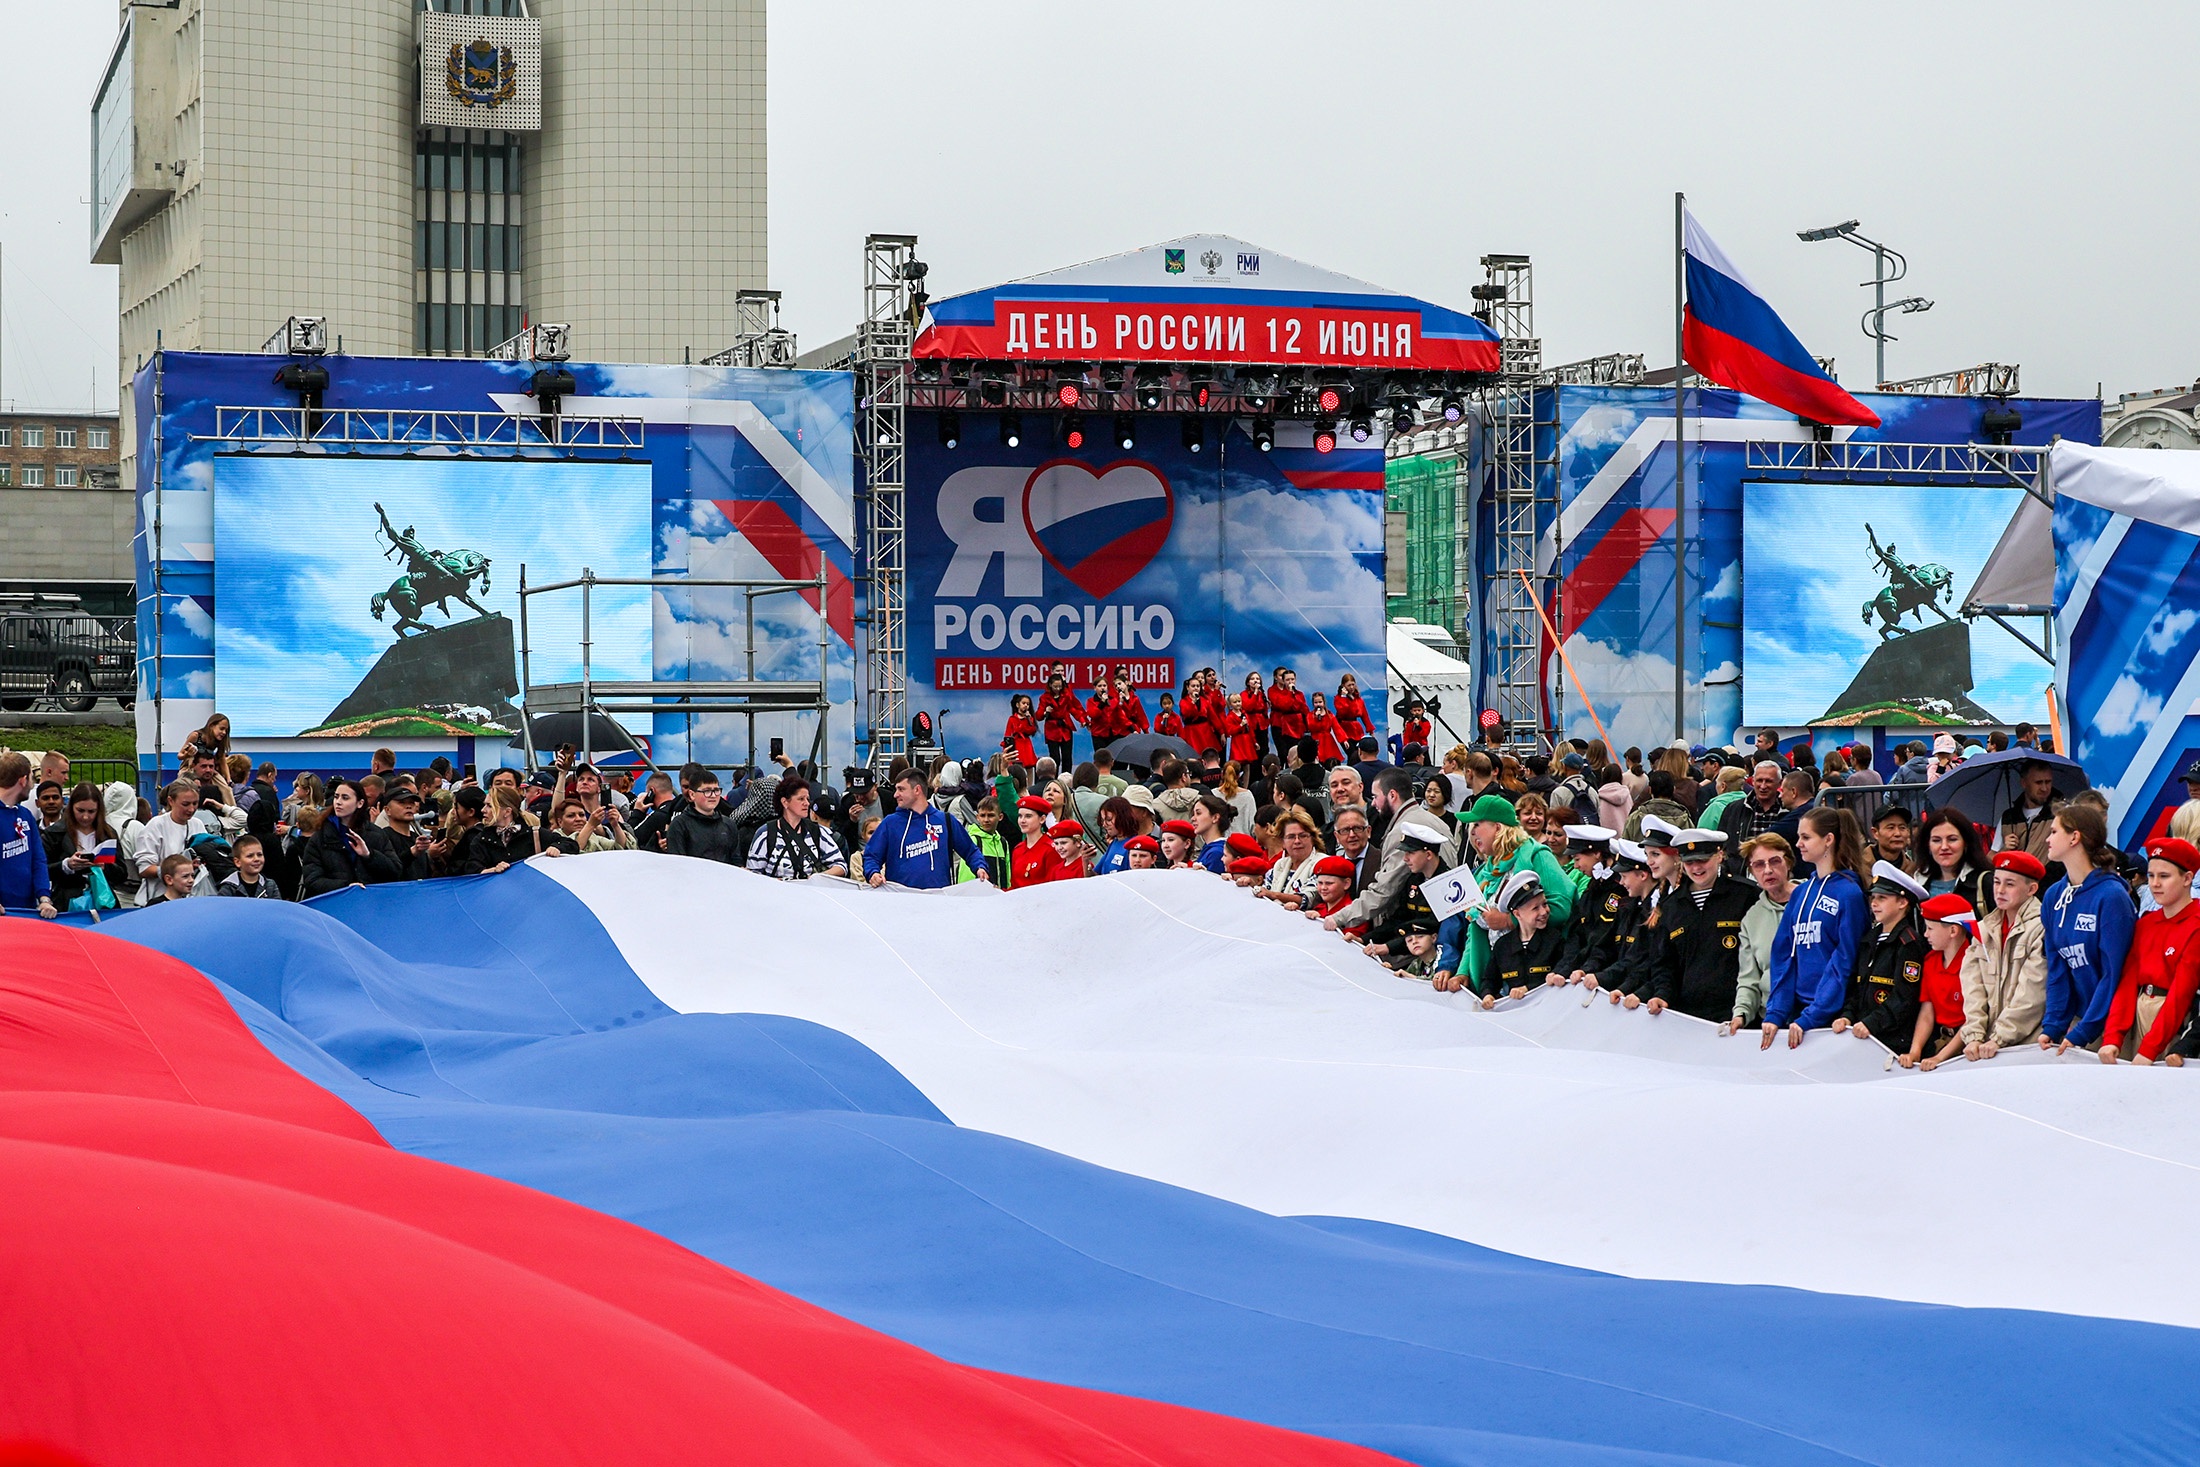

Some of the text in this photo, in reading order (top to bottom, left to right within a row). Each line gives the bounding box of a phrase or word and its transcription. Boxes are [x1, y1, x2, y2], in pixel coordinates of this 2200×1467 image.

[1237, 254, 1260, 271] РМИ
[1006, 312, 1412, 358] ДЕНЬ РОССИИ 12 ИЮНЯ
[934, 465, 1044, 597] Я
[933, 603, 1175, 651] РОССИЮ
[941, 663, 1170, 687] ДЕНЬ РОССИ 12 ЮНЯ
